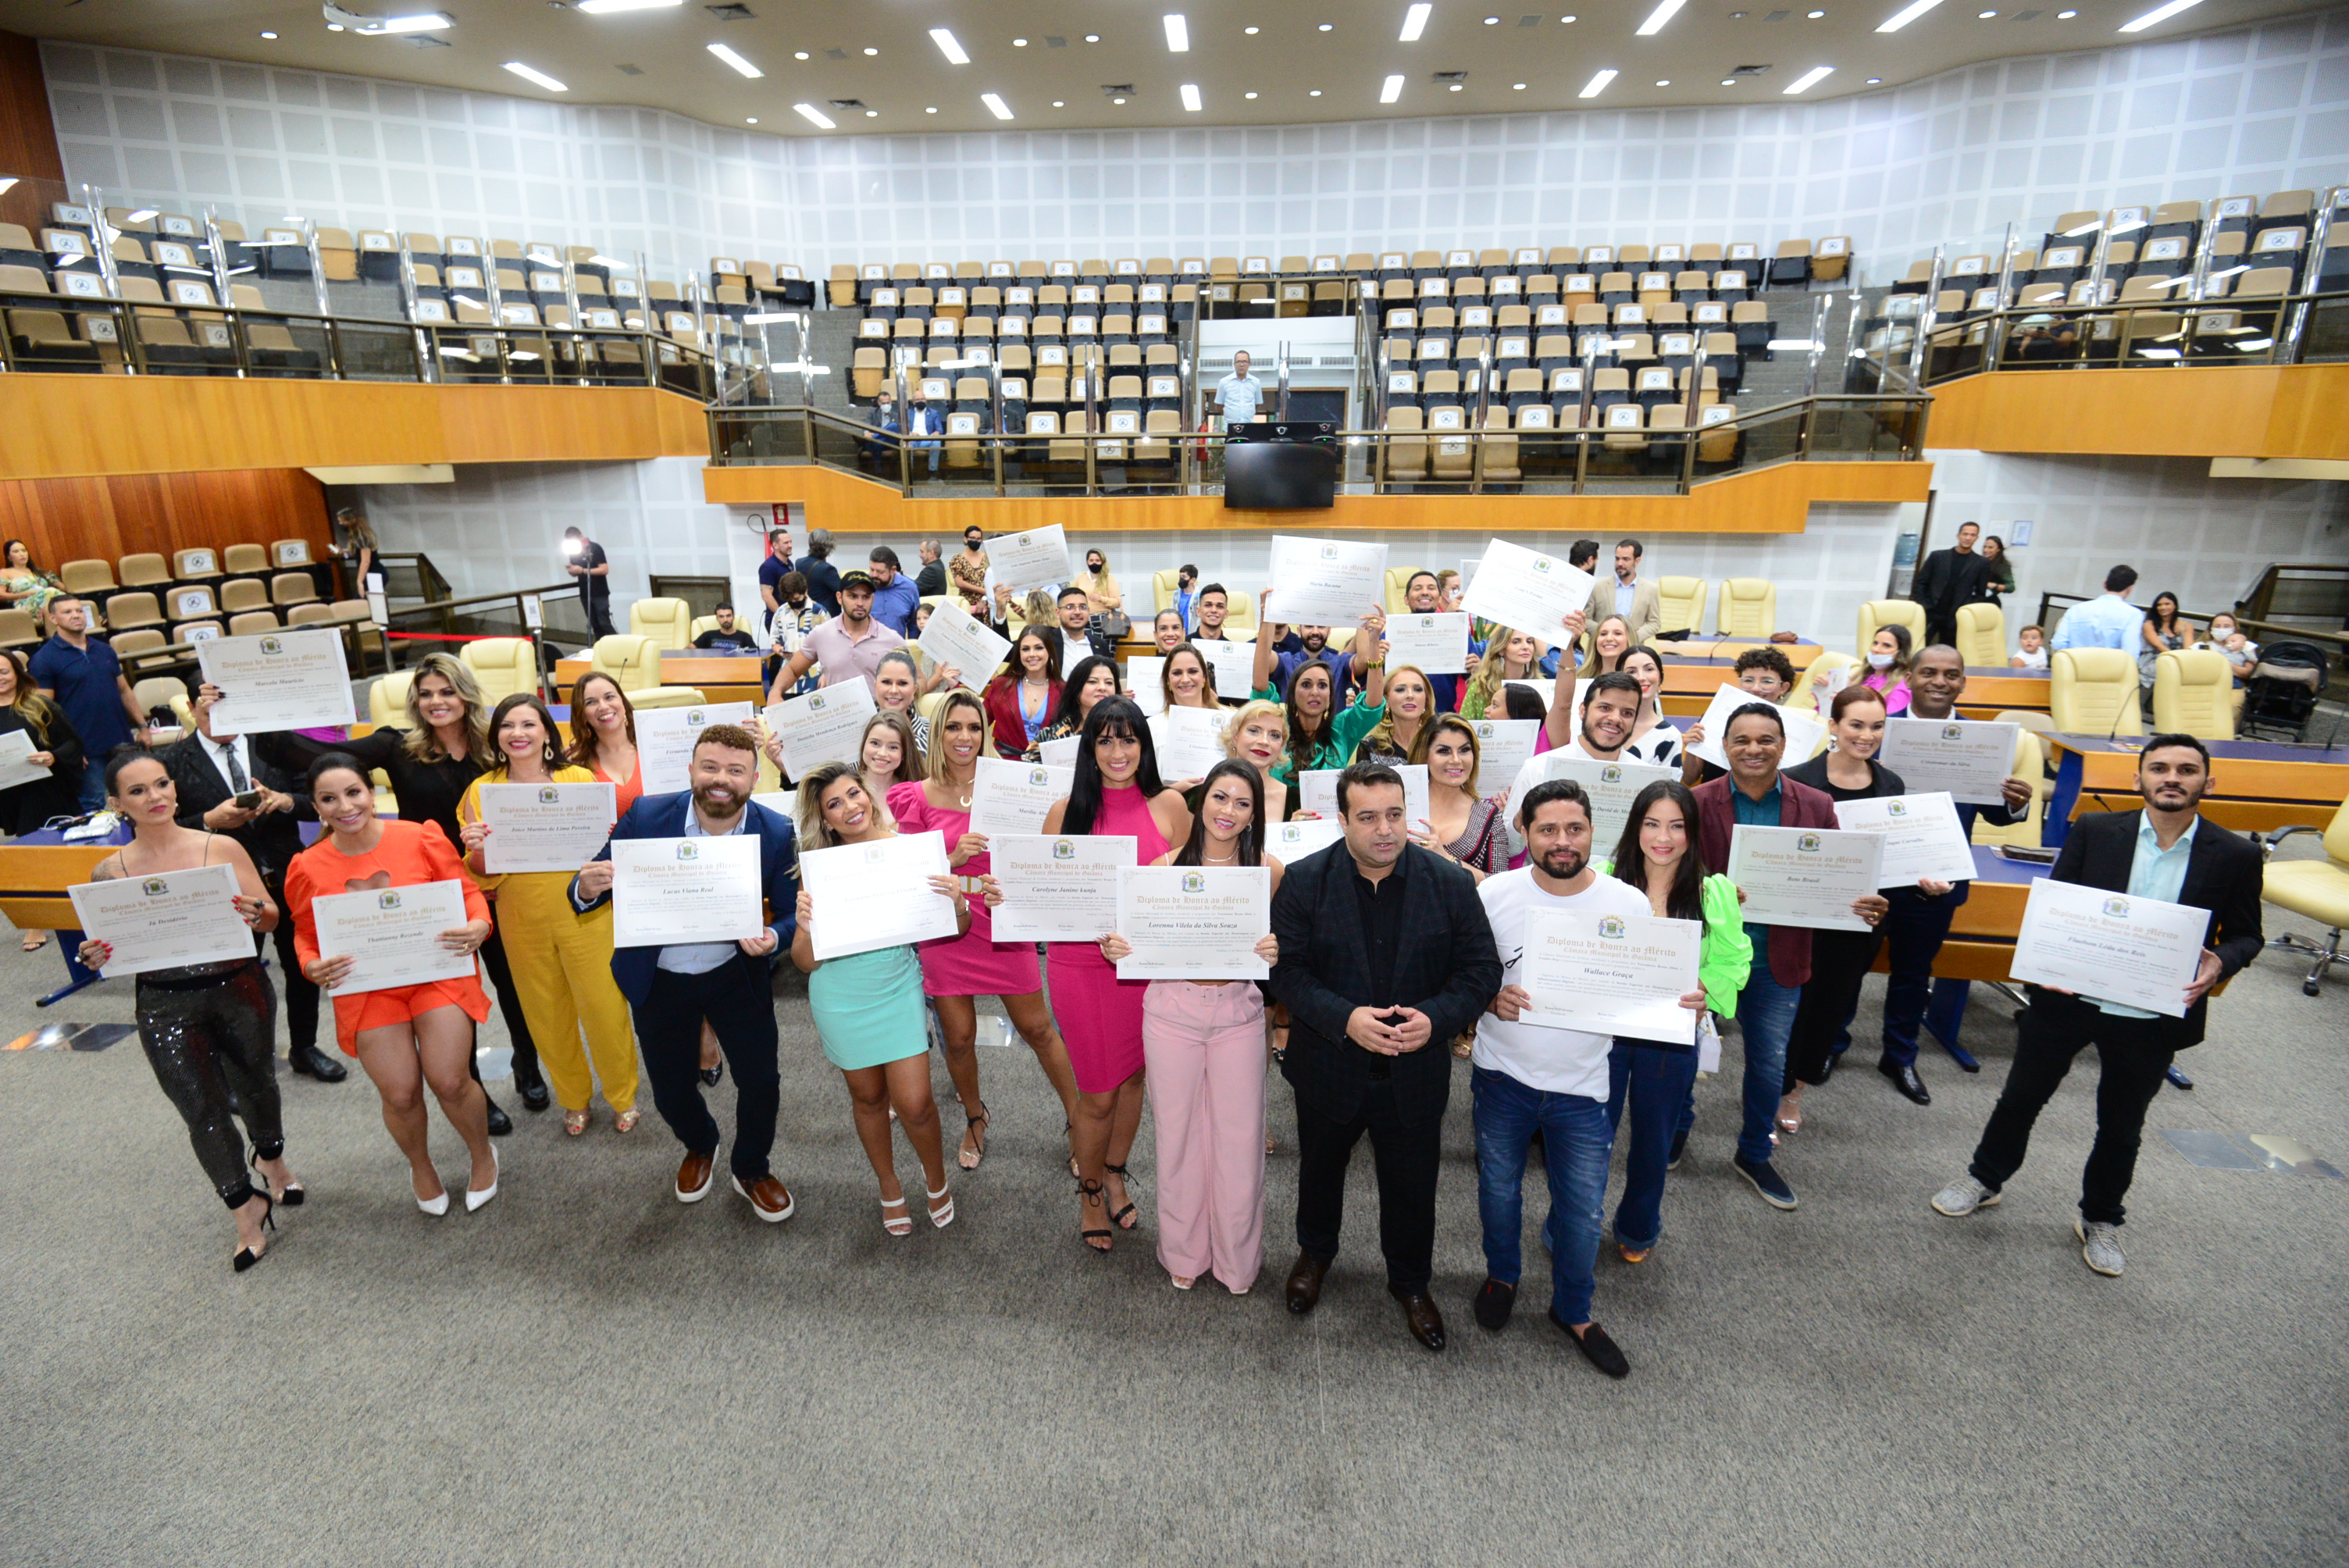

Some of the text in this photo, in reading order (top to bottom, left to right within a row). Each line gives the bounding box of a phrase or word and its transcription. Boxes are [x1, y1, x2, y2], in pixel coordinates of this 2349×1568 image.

[222, 660, 252, 670] Diploma
[266, 657, 288, 665] Honra
[301, 654, 326, 662] Mérito
[783, 717, 806, 729] Diploma
[814, 709, 832, 718] Honra
[840, 700, 859, 710] Mérito
[991, 783, 1018, 792] Diploma
[1752, 851, 1784, 860] Diploma
[101, 902, 136, 914] Diploma
[150, 896, 176, 905] Honra
[191, 889, 219, 899] Mérito
[1137, 896, 1170, 905] Diploma
[1222, 896, 1249, 904] Mérito
[337, 915, 369, 927] Diploma
[383, 911, 407, 920] Honra
[420, 905, 446, 915] Mérito
[2049, 907, 2087, 922] Diploma
[2103, 918, 2131, 930] Honra
[2147, 927, 2178, 940] Mérito
[1547, 936, 1584, 949] Diploma
[1588, 940, 1597, 949] de
[1601, 942, 1629, 952] Honra
[1645, 946, 1676, 957] Mérito
[1590, 950, 1621, 958] Municipal
[1584, 968, 1633, 979] Wallace Graça
